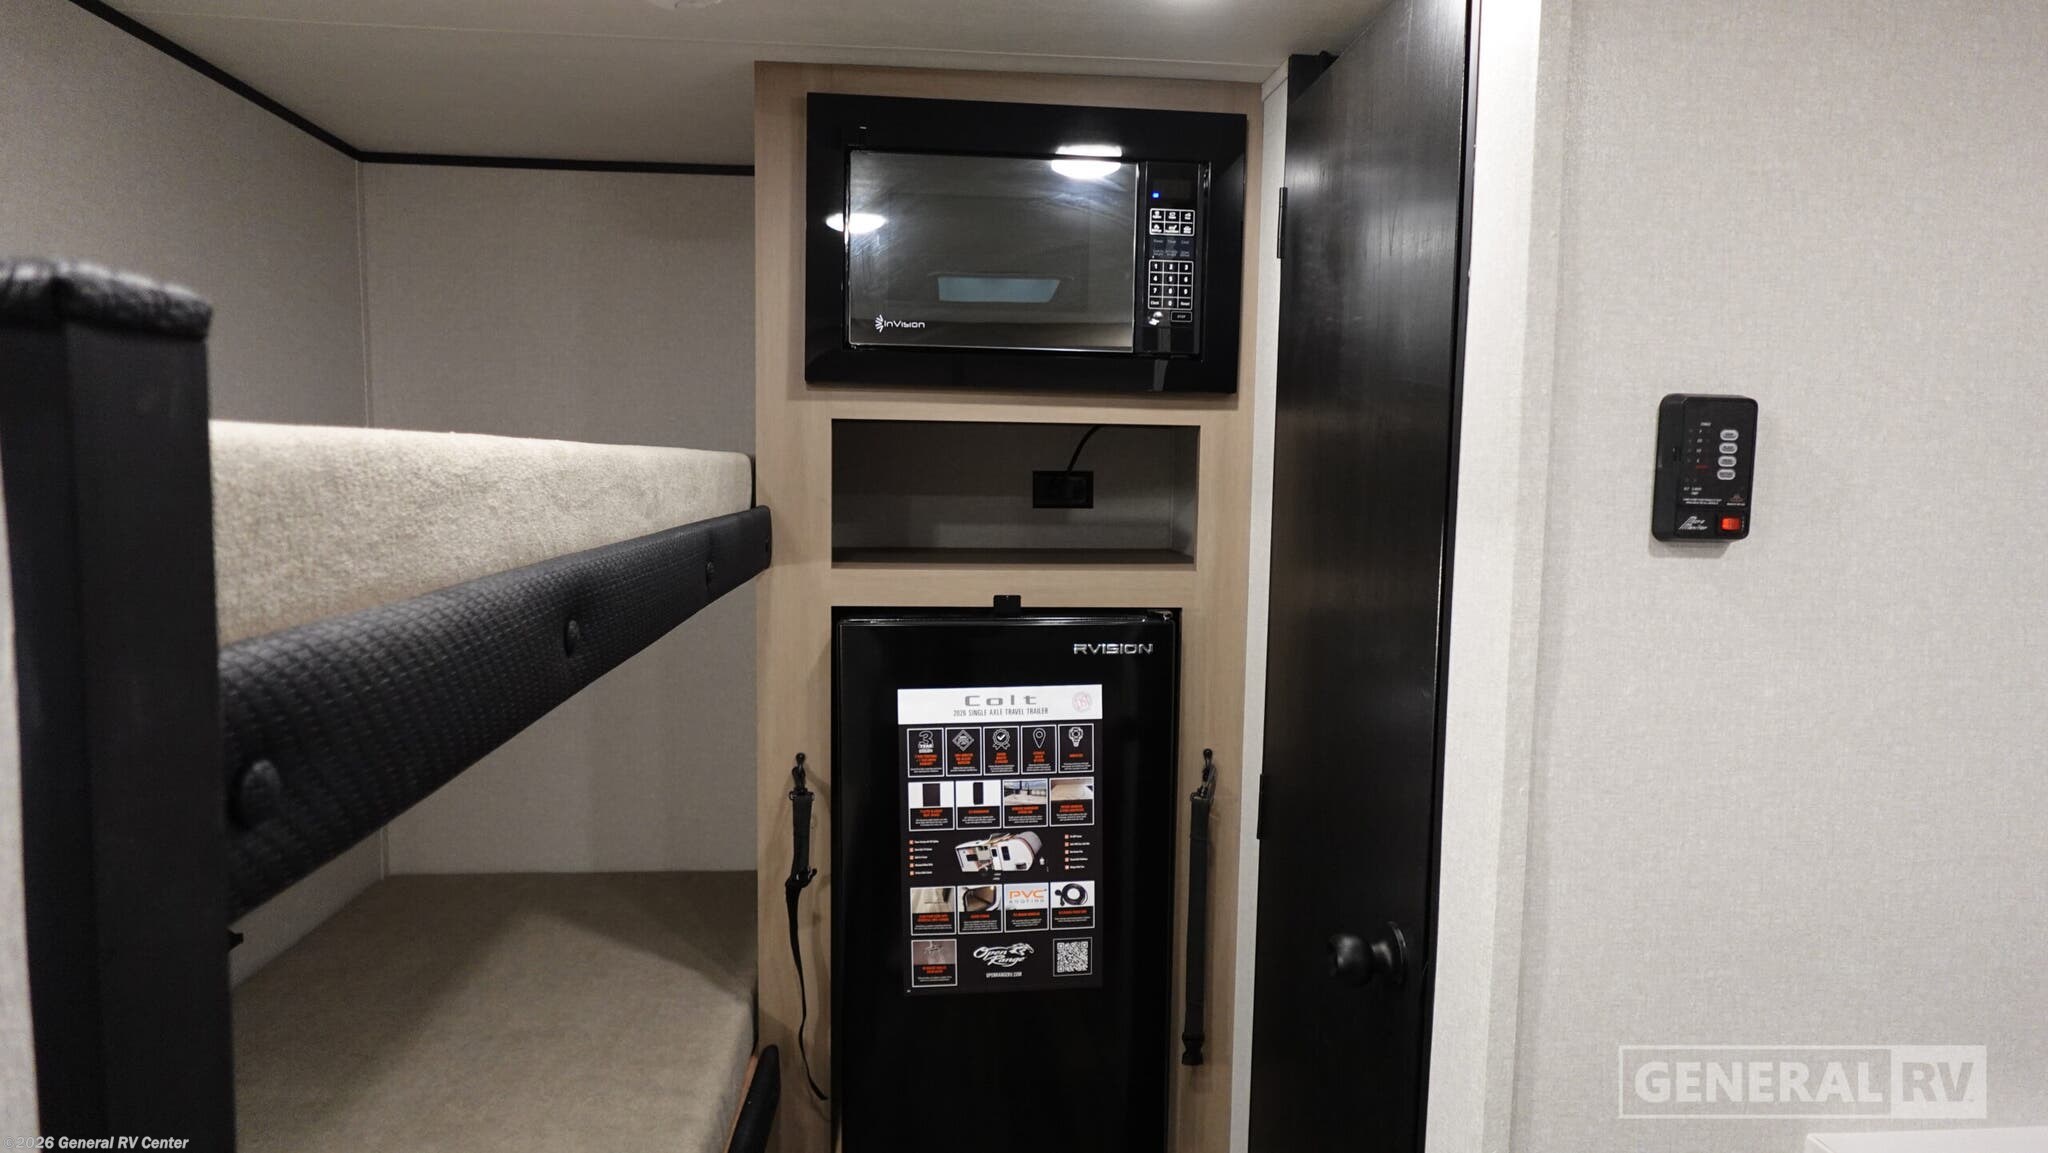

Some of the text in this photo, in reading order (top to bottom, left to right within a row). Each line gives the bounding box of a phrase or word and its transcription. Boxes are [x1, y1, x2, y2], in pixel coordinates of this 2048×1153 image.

[1073, 643, 1154, 655] RVISION
[964, 694, 1037, 707] Colt
[968, 708, 988, 716] SINGLE
[989, 708, 1003, 716] AXLE
[1005, 707, 1025, 715] TRAVEL
[1026, 707, 1049, 715] TRAILER
[1008, 888, 1045, 900] PVC
[973, 946, 1008, 961] Open
